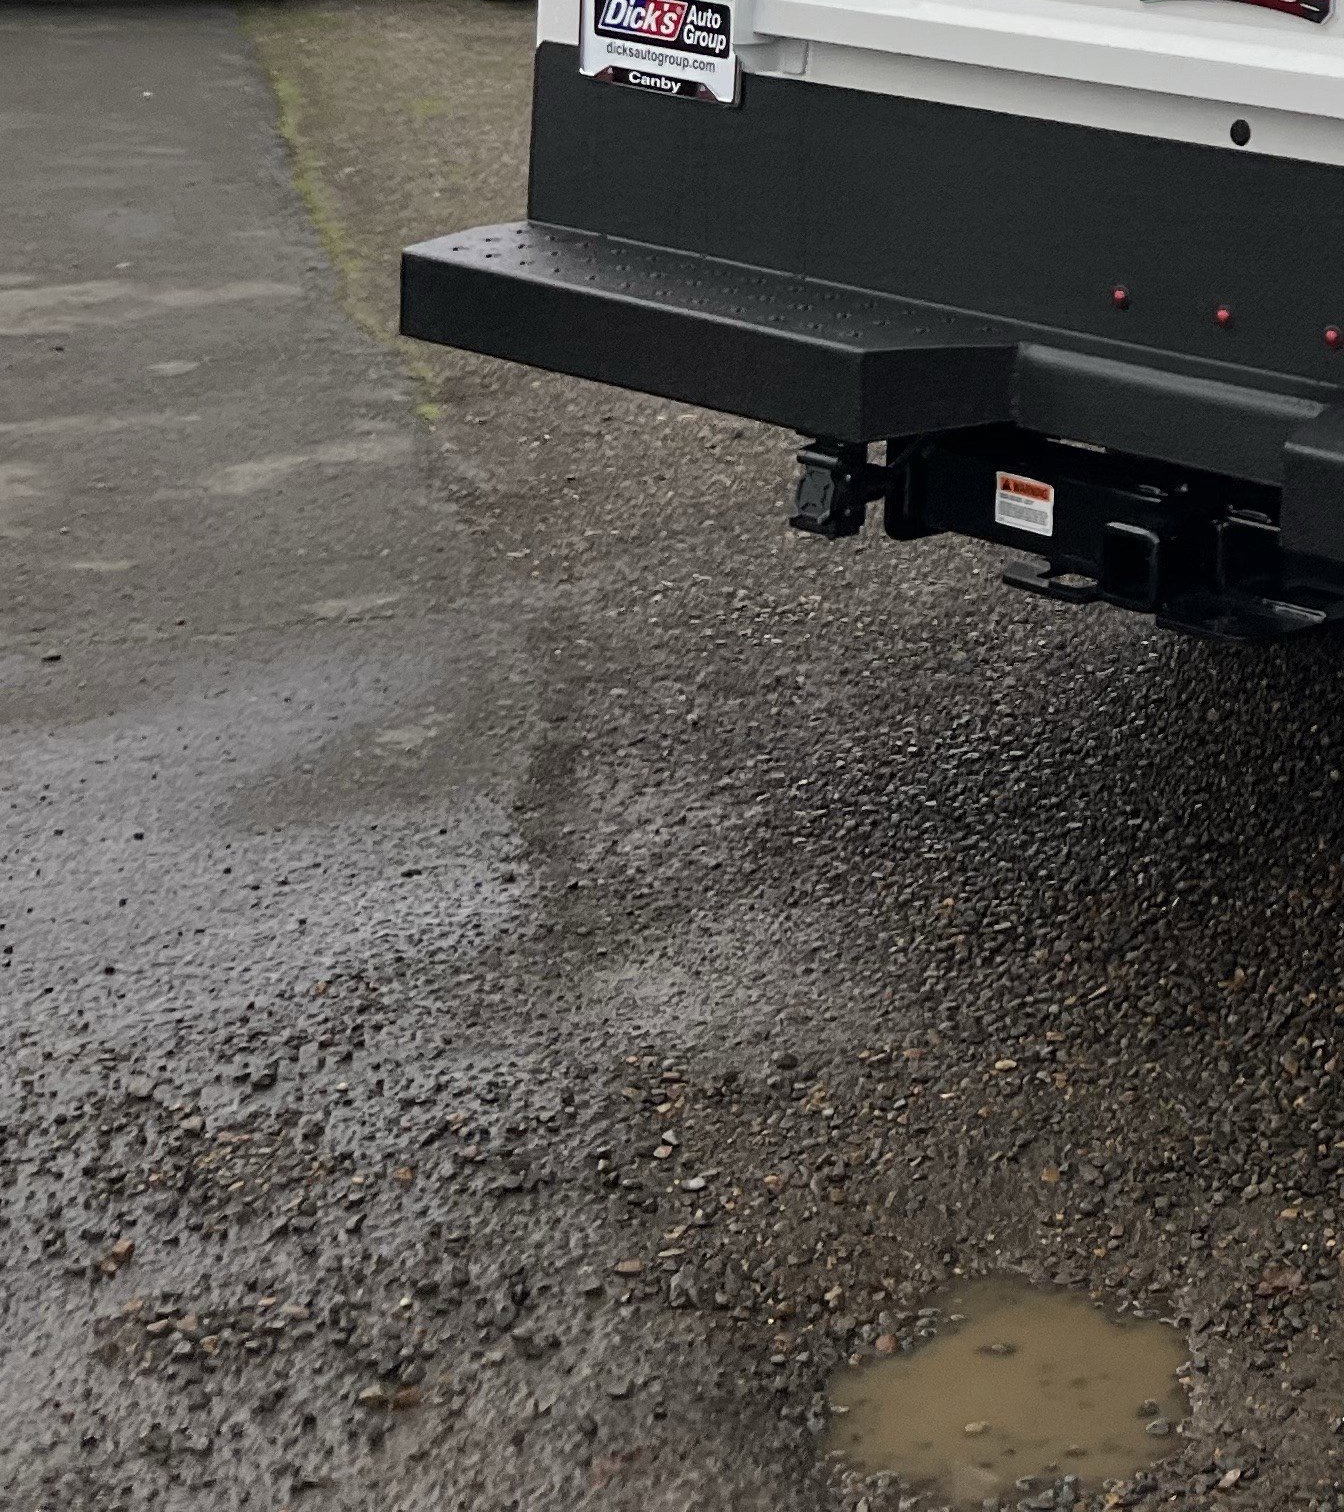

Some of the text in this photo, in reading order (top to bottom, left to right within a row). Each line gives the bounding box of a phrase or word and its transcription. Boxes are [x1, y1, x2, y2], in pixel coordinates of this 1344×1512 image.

[686, 4, 722, 29] Auto
[683, 24, 727, 53] Group
[606, 41, 716, 73] dicksautogroup.com
[628, 71, 682, 94] Canby
